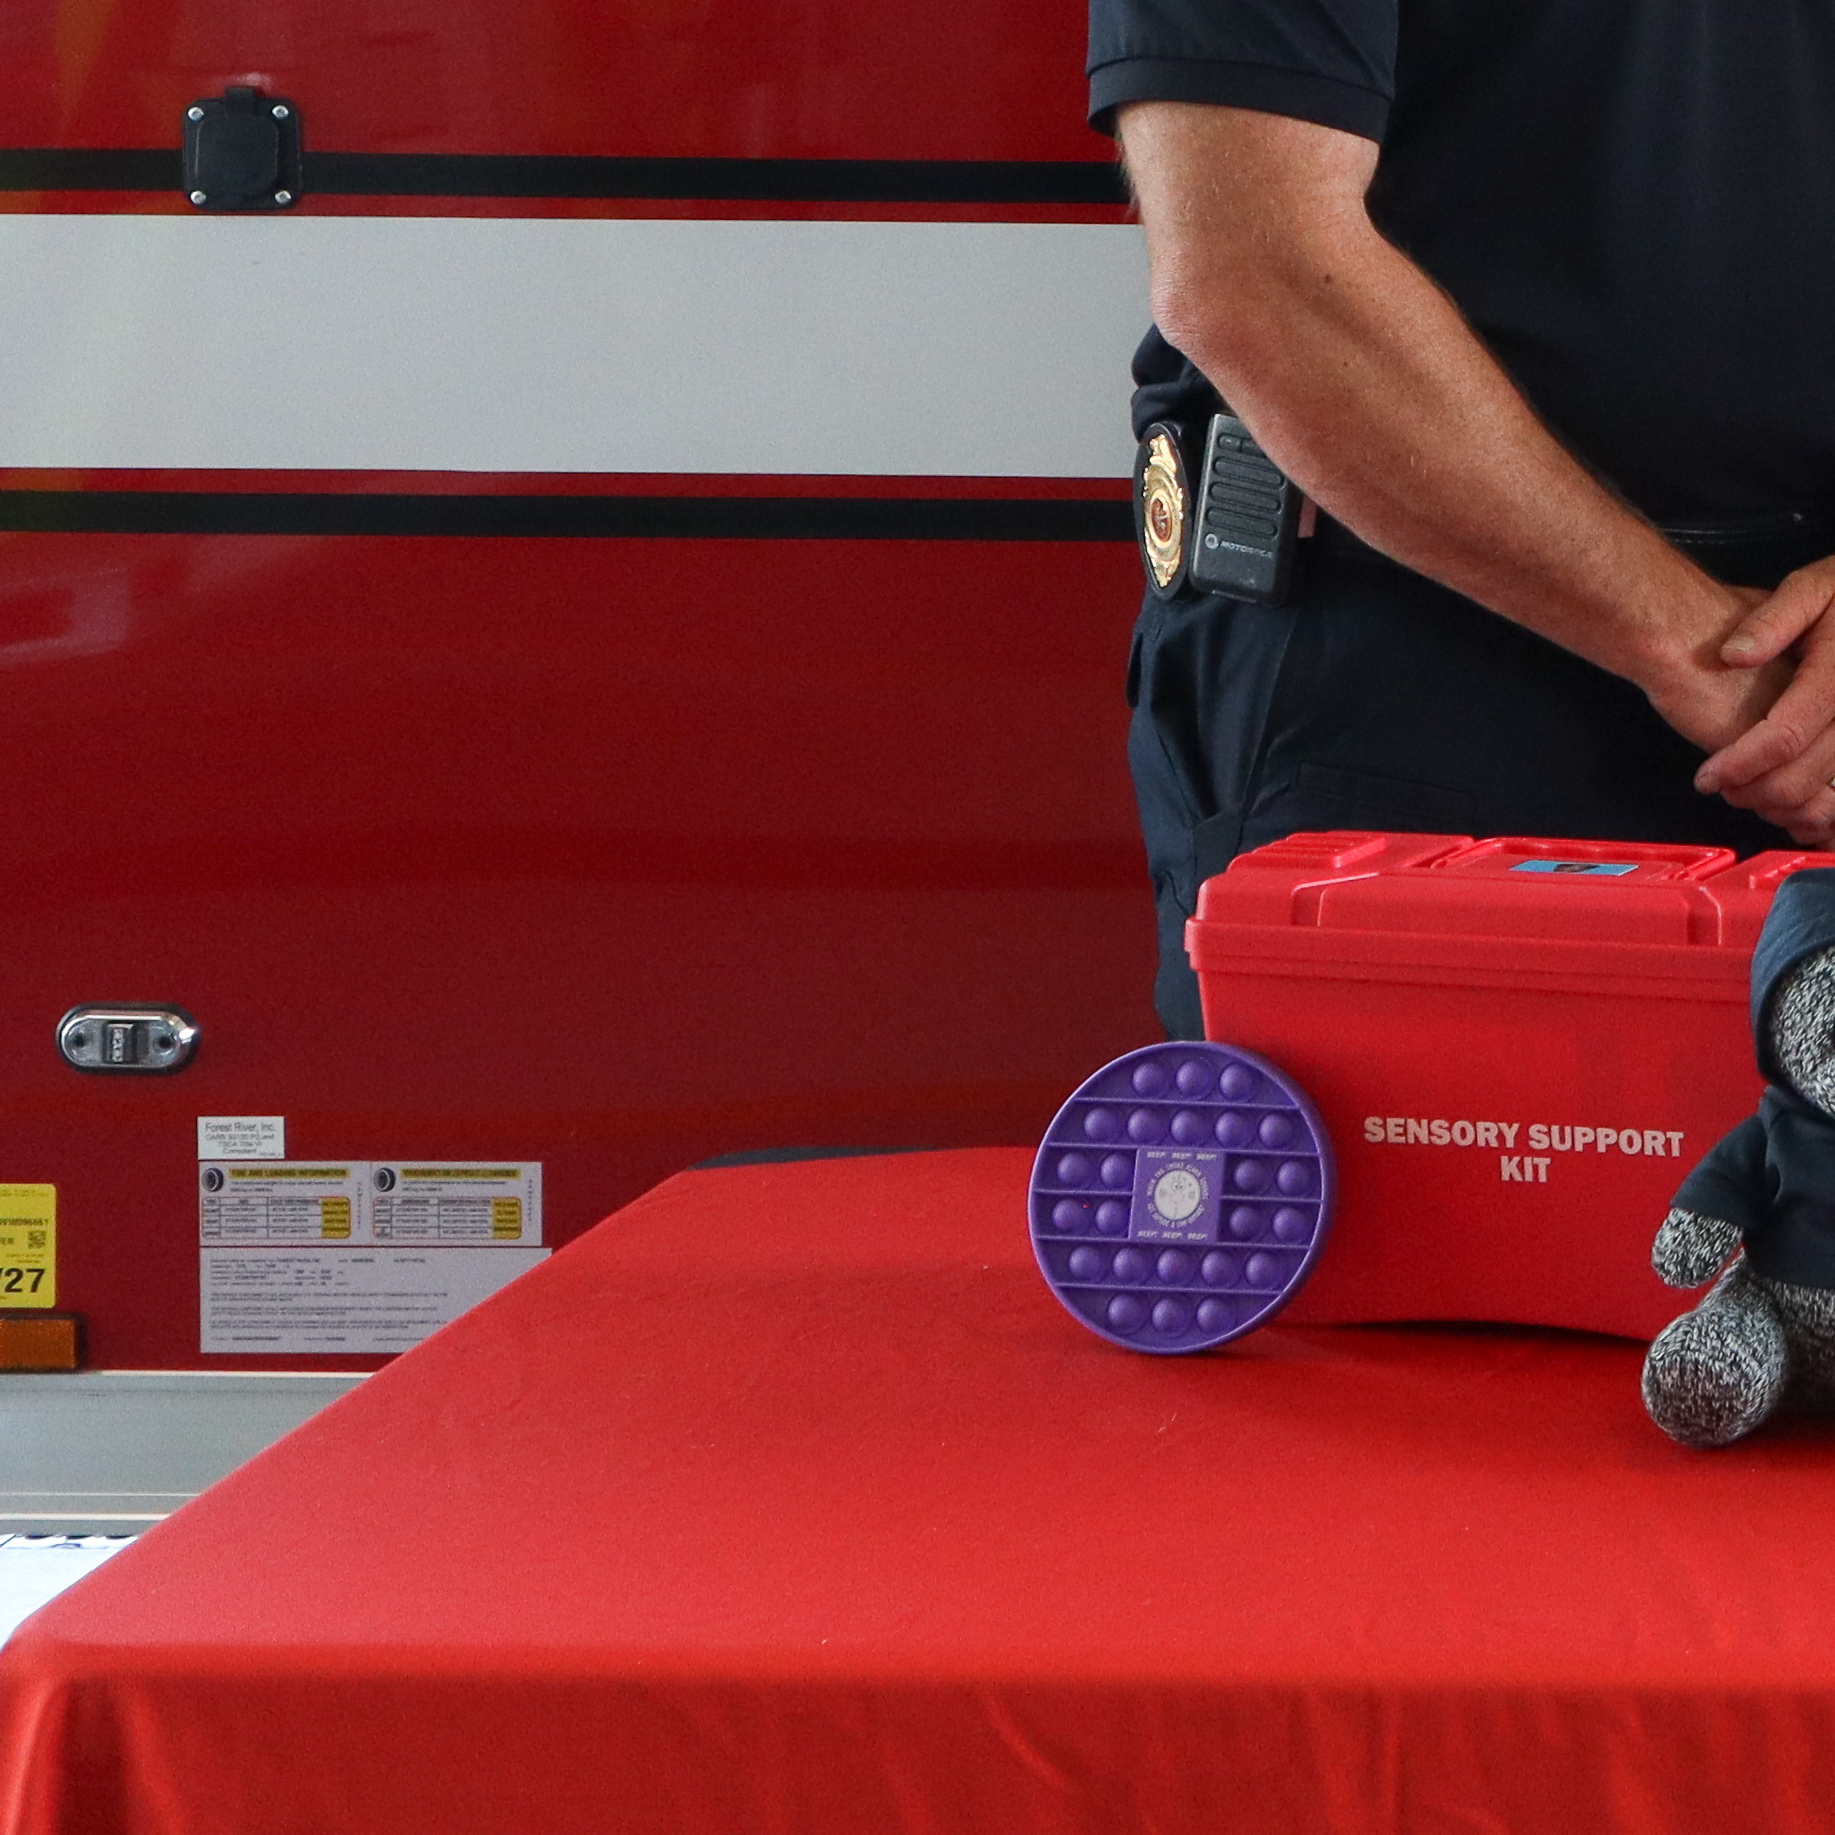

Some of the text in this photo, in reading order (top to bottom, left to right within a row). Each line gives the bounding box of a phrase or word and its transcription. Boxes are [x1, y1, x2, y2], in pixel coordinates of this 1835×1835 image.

[205, 1122, 276, 1133] Forest River, Inc.
[1363, 1115, 1685, 1158] SENSORY SUPPORT
[1499, 1154, 1552, 1184] KIT
